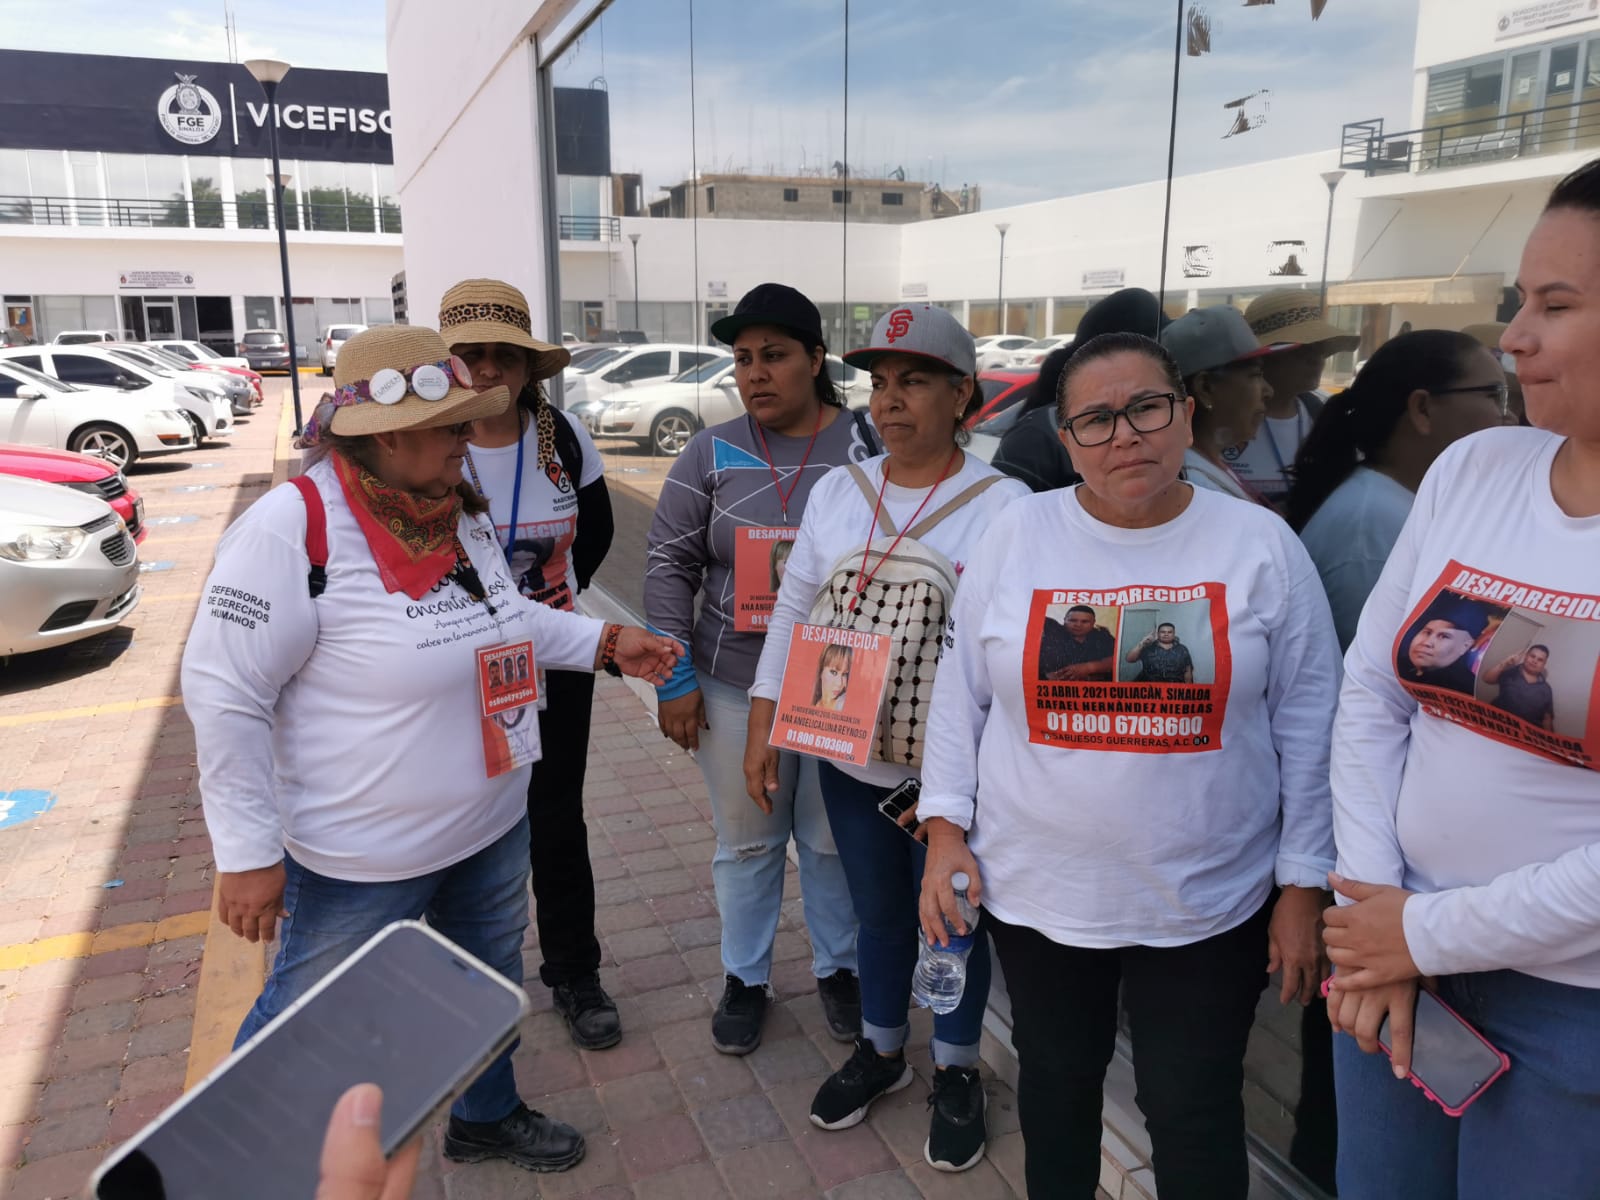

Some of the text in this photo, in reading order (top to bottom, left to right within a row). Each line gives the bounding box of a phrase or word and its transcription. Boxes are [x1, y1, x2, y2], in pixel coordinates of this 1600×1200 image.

[177, 116, 205, 127] FGE
[211, 585, 271, 611] DEFENSORAS
[1051, 585, 1207, 606] DESAPARECIDO
[207, 596, 270, 623] DE DERECHOS
[211, 608, 256, 630] HUMANOS
[751, 615, 762, 624] 01
[802, 625, 879, 650] DESAPARECIDA
[483, 645, 529, 662] DESAPARECIDOS
[1037, 685, 1051, 698] 23
[1051, 686, 1081, 698] ABRIL
[1083, 687, 1108, 699] 2021
[1167, 688, 1211, 701] SINALOA
[1037, 700, 1079, 711] RAFAEL
[1160, 703, 1213, 714] NIEBLAS
[781, 713, 793, 724] ANA
[1047, 712, 1203, 737] 01 800 6703600
[787, 729, 853, 754] 01 800 6703600
